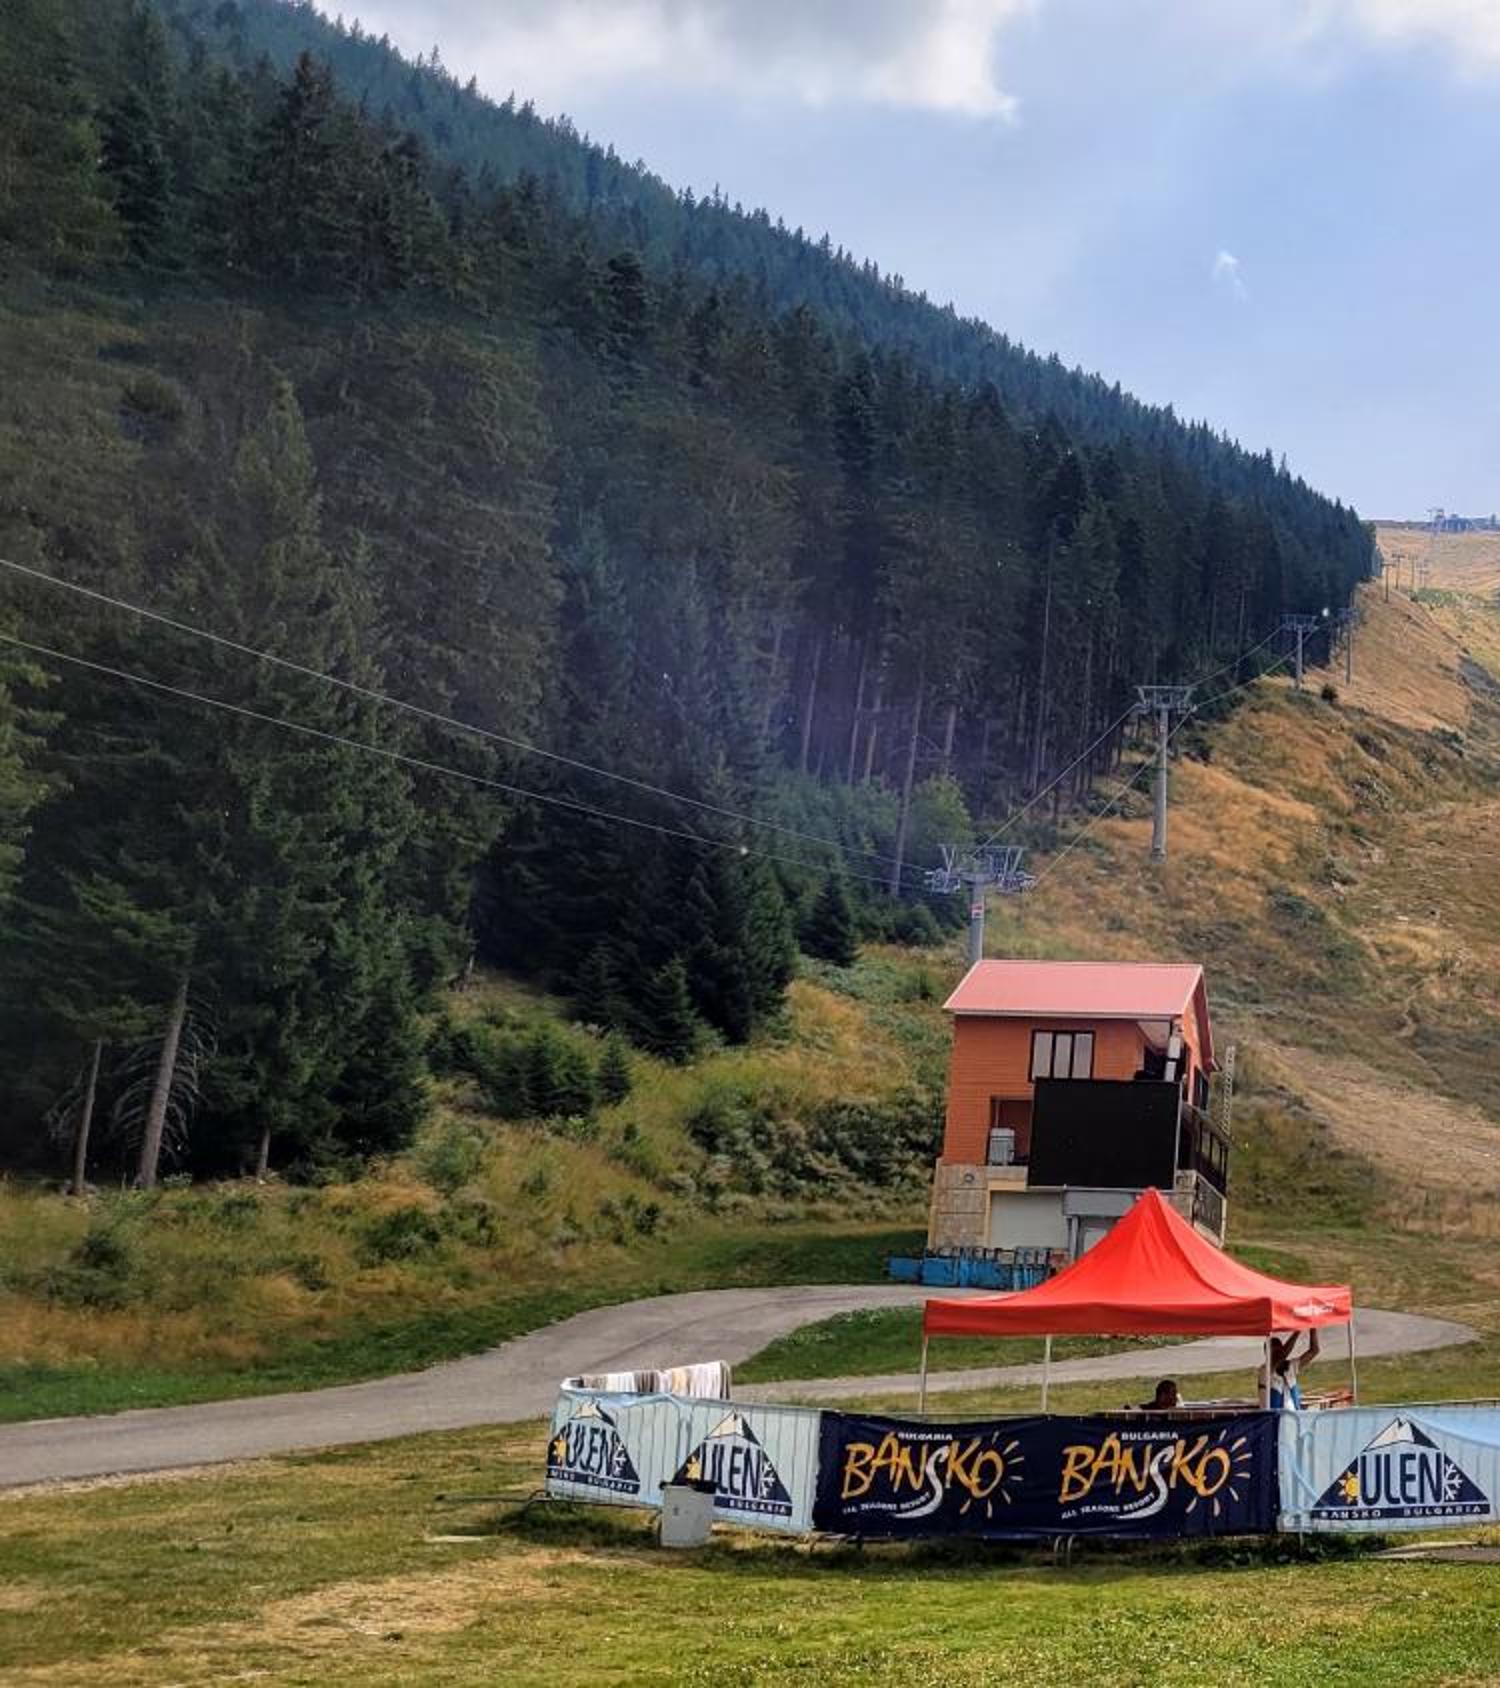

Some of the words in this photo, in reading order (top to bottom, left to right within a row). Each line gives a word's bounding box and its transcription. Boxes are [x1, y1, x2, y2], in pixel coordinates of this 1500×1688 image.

[565, 1421, 617, 1477] ULEN
[897, 1432, 954, 1441] BULGARIA
[1121, 1431, 1179, 1441] BULGARIA
[702, 1442, 761, 1499] ULEN
[841, 1431, 1004, 1519] BANSKO
[1058, 1431, 1231, 1520] BANSKO
[1360, 1452, 1444, 1507] ULEN
[1320, 1509, 1382, 1519] BANSKO
[1403, 1505, 1482, 1517] BULGARIA
